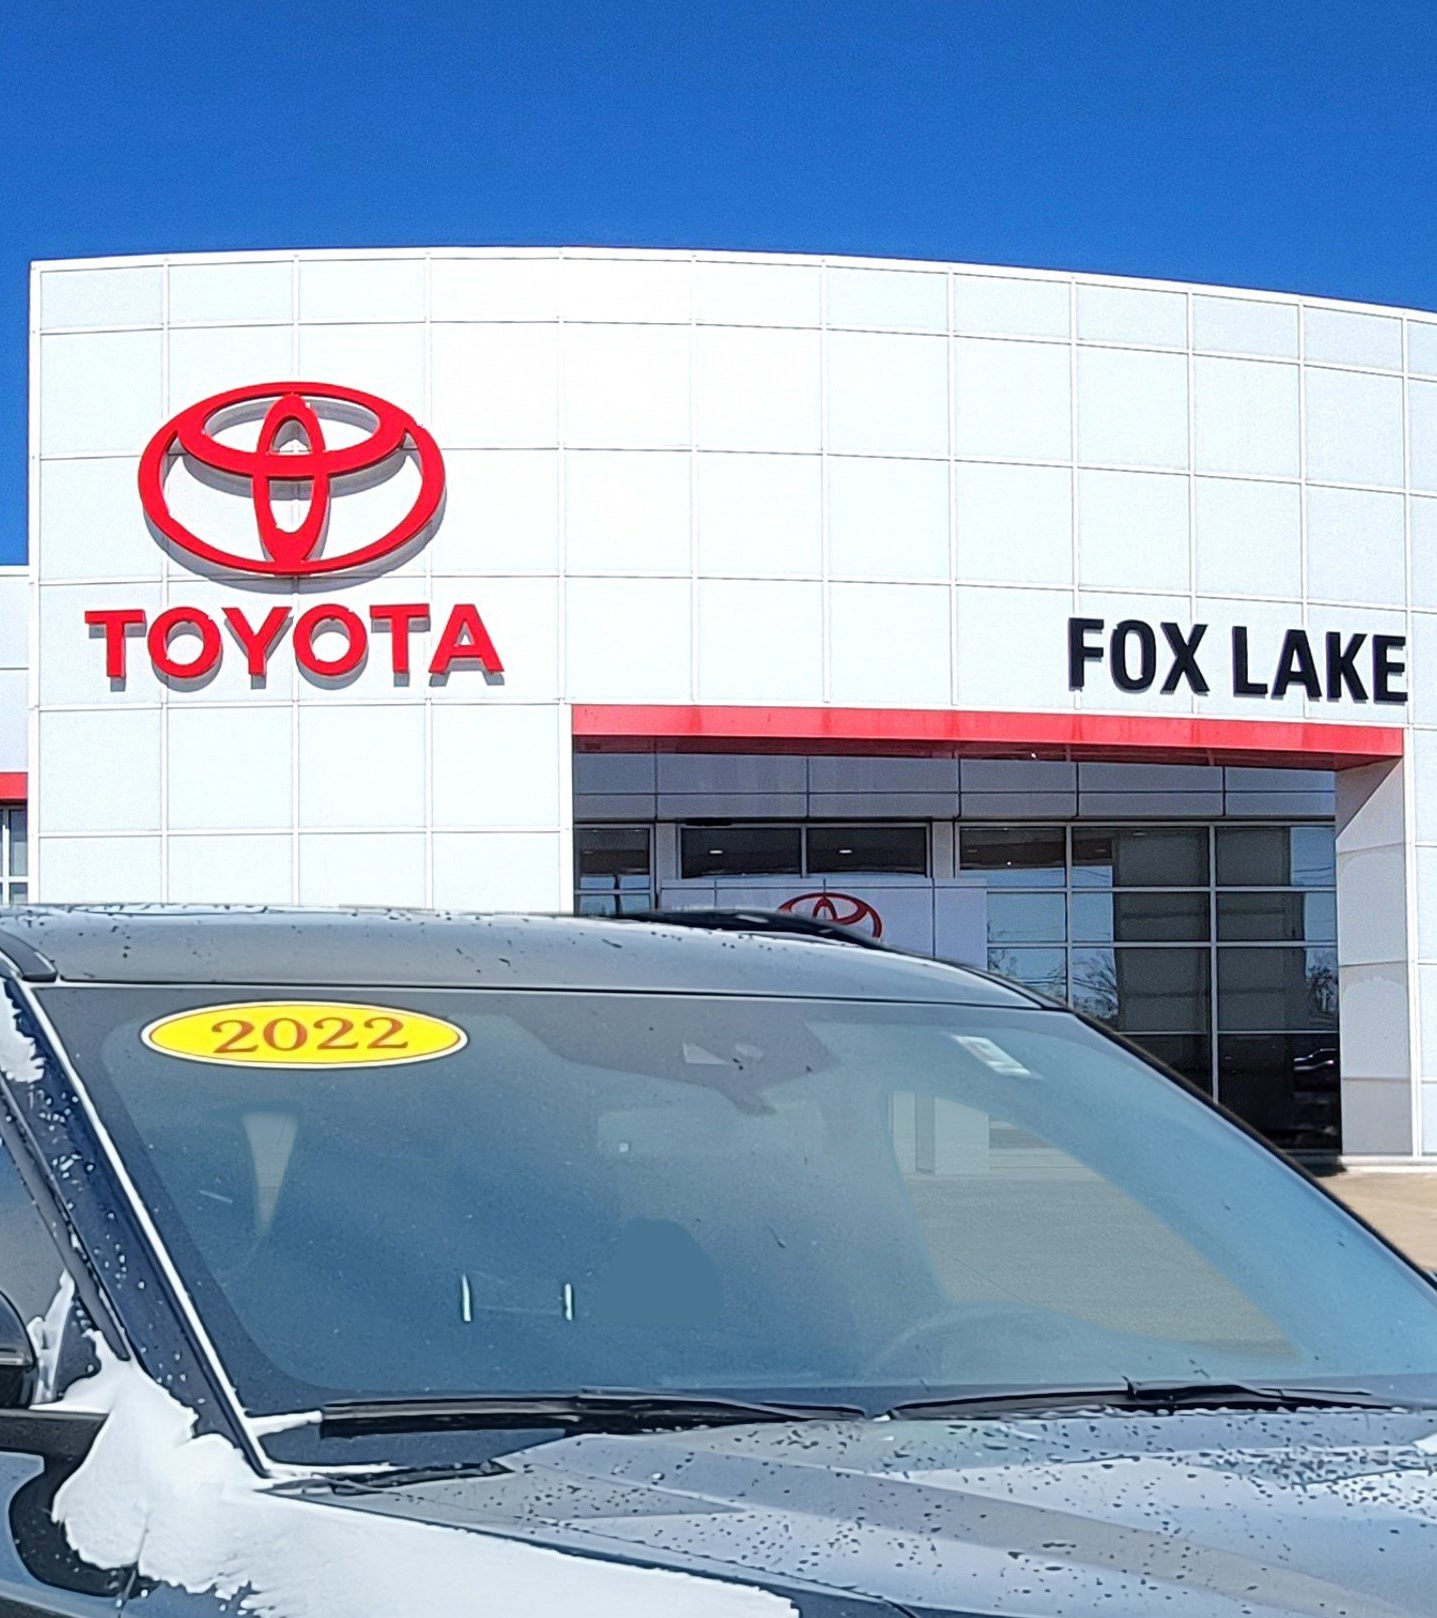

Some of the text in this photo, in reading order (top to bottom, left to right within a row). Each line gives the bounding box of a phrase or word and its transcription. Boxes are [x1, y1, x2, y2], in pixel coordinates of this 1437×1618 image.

[84, 602, 505, 692] TOYOTA
[1068, 616, 1409, 705] FOX LAKE
[211, 1016, 409, 1054] 2022
